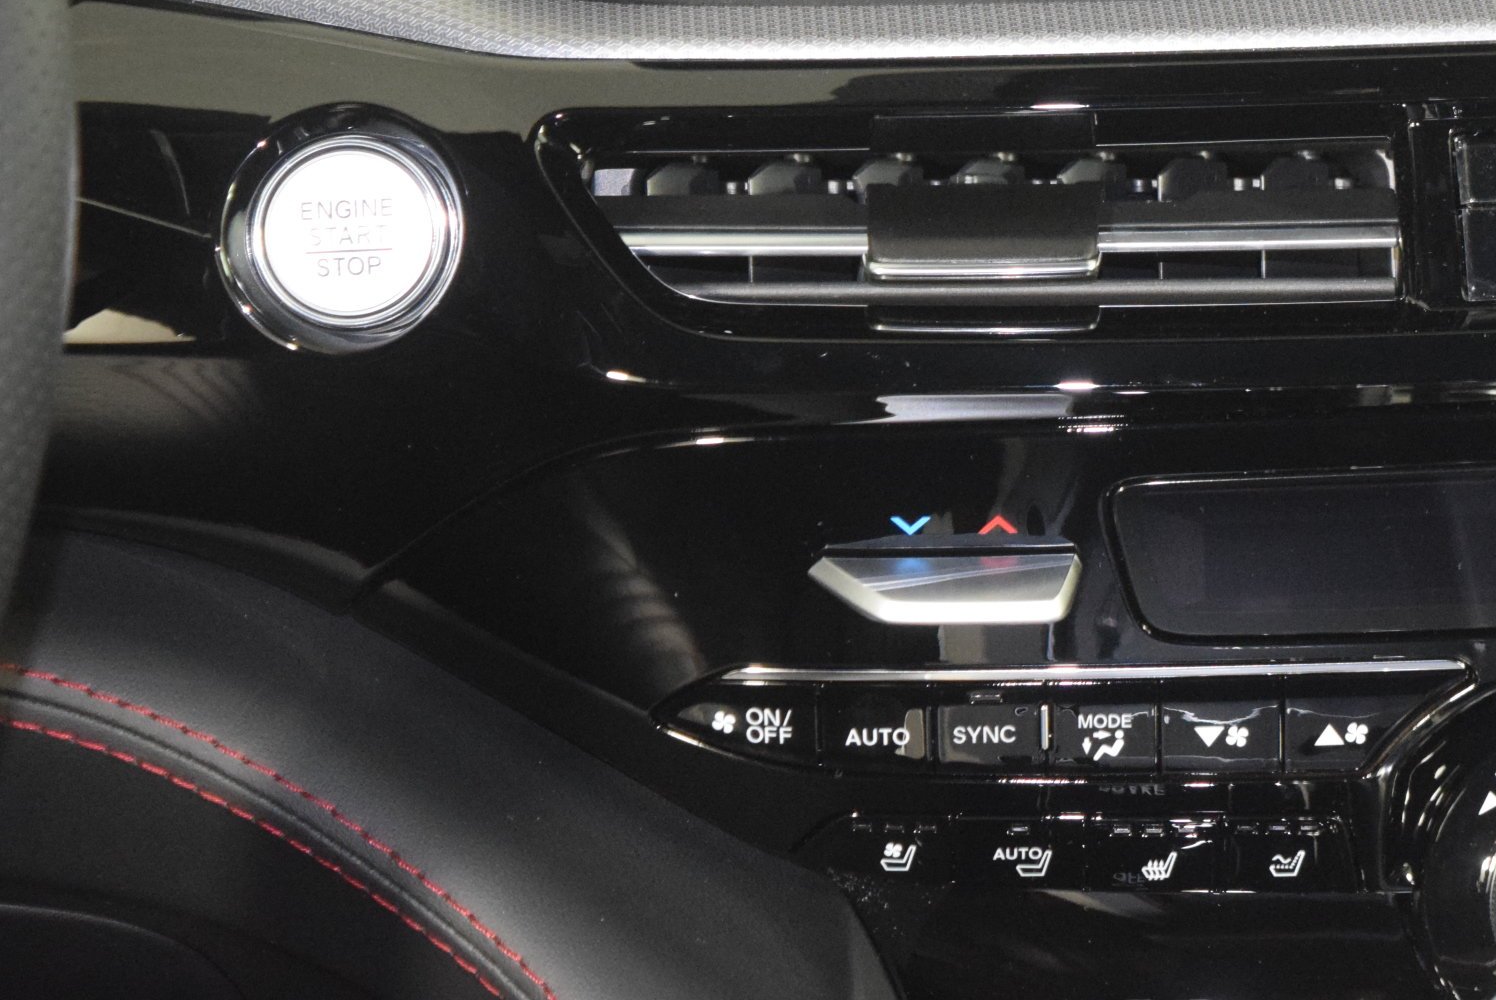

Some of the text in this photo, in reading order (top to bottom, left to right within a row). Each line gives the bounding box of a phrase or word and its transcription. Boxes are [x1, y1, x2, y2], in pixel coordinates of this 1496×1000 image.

[301, 198, 392, 221] ENGINE
[311, 224, 388, 247] START
[317, 256, 382, 278] STOP
[745, 706, 792, 727] ON/
[1078, 713, 1132, 729] MODE
[745, 726, 793, 745] OFF
[845, 727, 911, 747] AUTO
[953, 725, 1016, 745] SYNC
[993, 846, 1042, 862] AUTO
